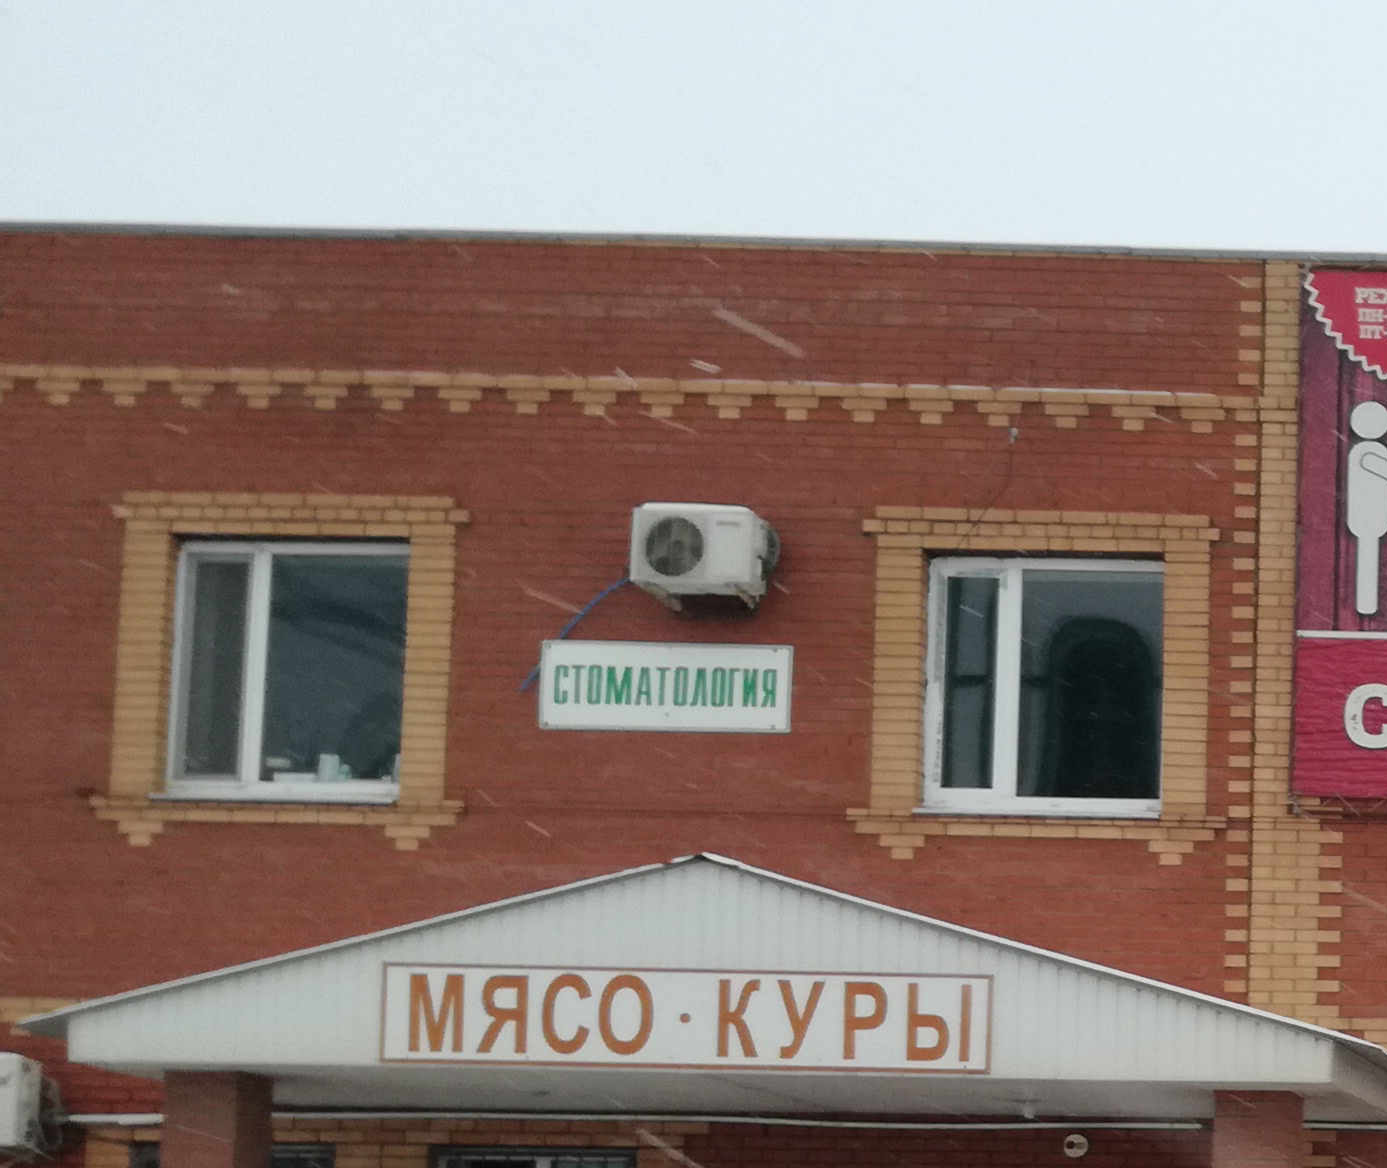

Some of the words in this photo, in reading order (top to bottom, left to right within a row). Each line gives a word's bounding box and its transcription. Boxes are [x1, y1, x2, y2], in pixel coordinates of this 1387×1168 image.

[552, 663, 778, 709] СТОМАТОЛОГИЯ
[407, 972, 655, 1056] МЯСО
[717, 978, 973, 1063] КУРЫ
